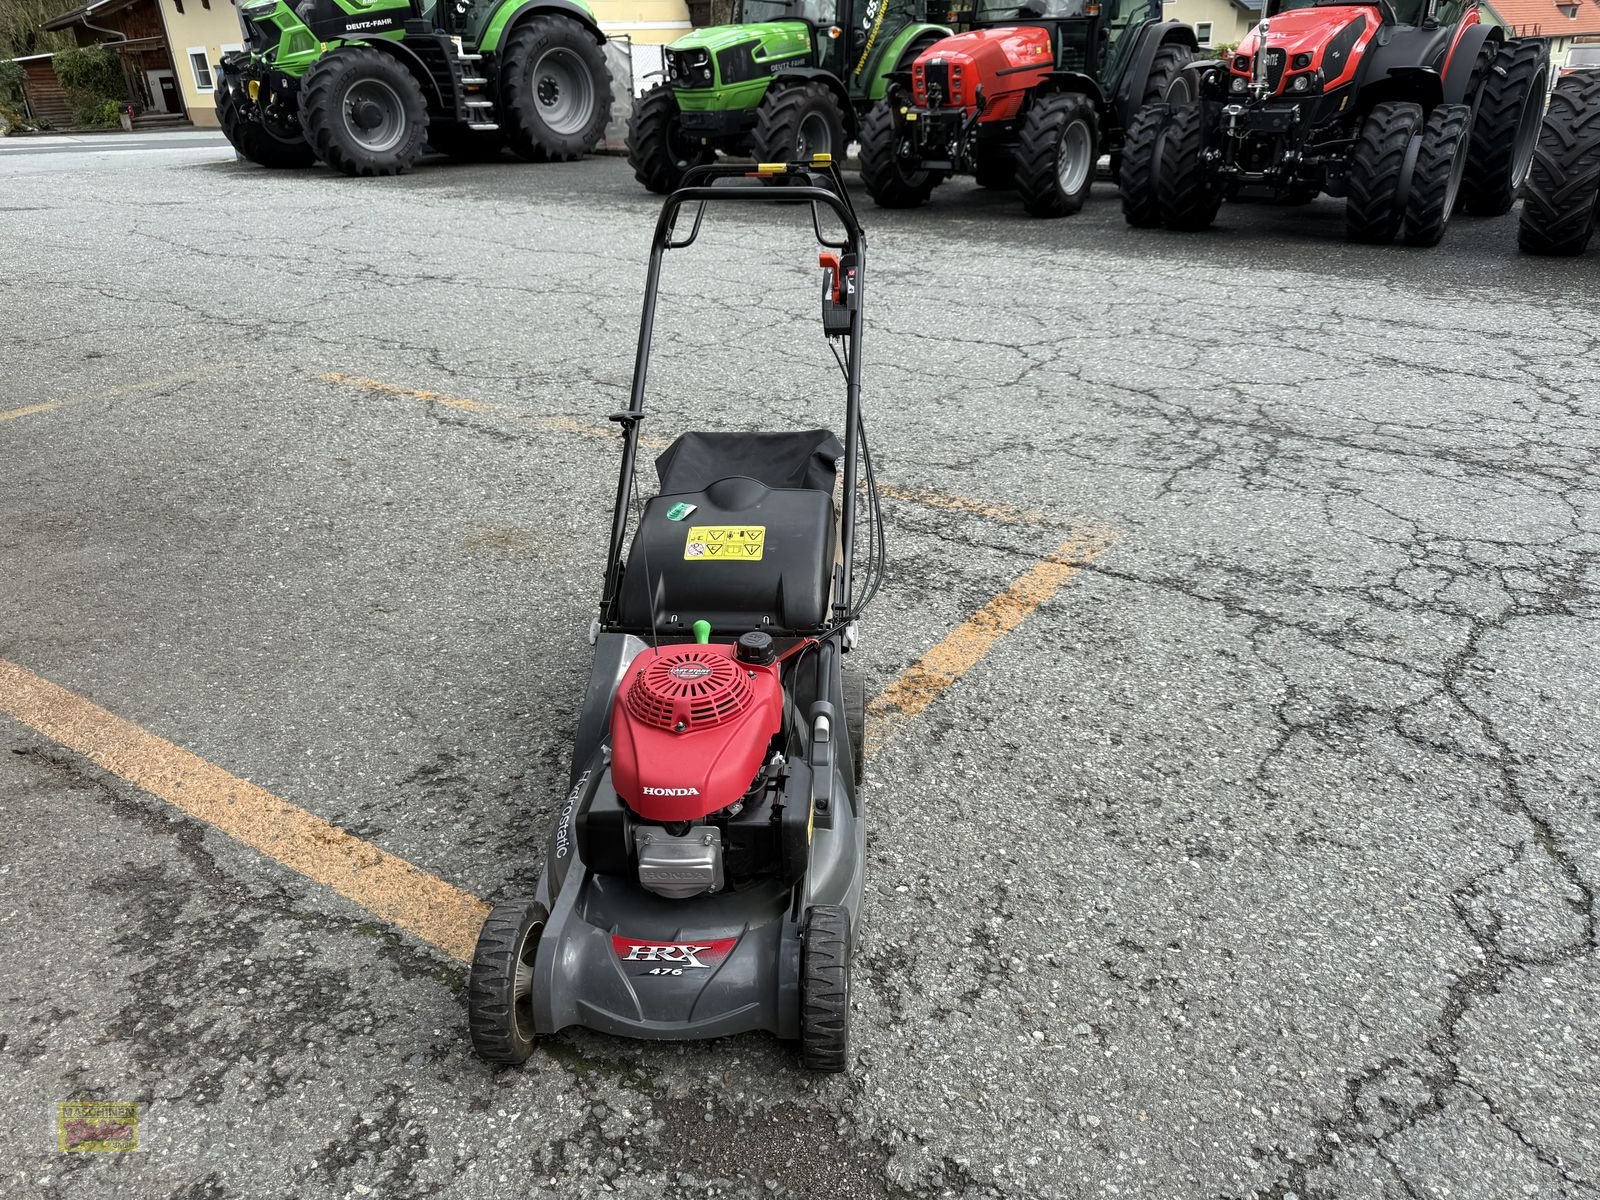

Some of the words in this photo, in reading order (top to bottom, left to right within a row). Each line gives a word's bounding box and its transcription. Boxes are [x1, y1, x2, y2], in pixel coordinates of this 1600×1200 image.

[345, 18, 393, 31] DEUTZ-FAHR
[642, 787, 700, 796] HONDA
[556, 769, 592, 859] Hydrostatic
[644, 872, 708, 880] HONDA
[622, 945, 712, 968] HRX
[649, 968, 683, 976] 476
